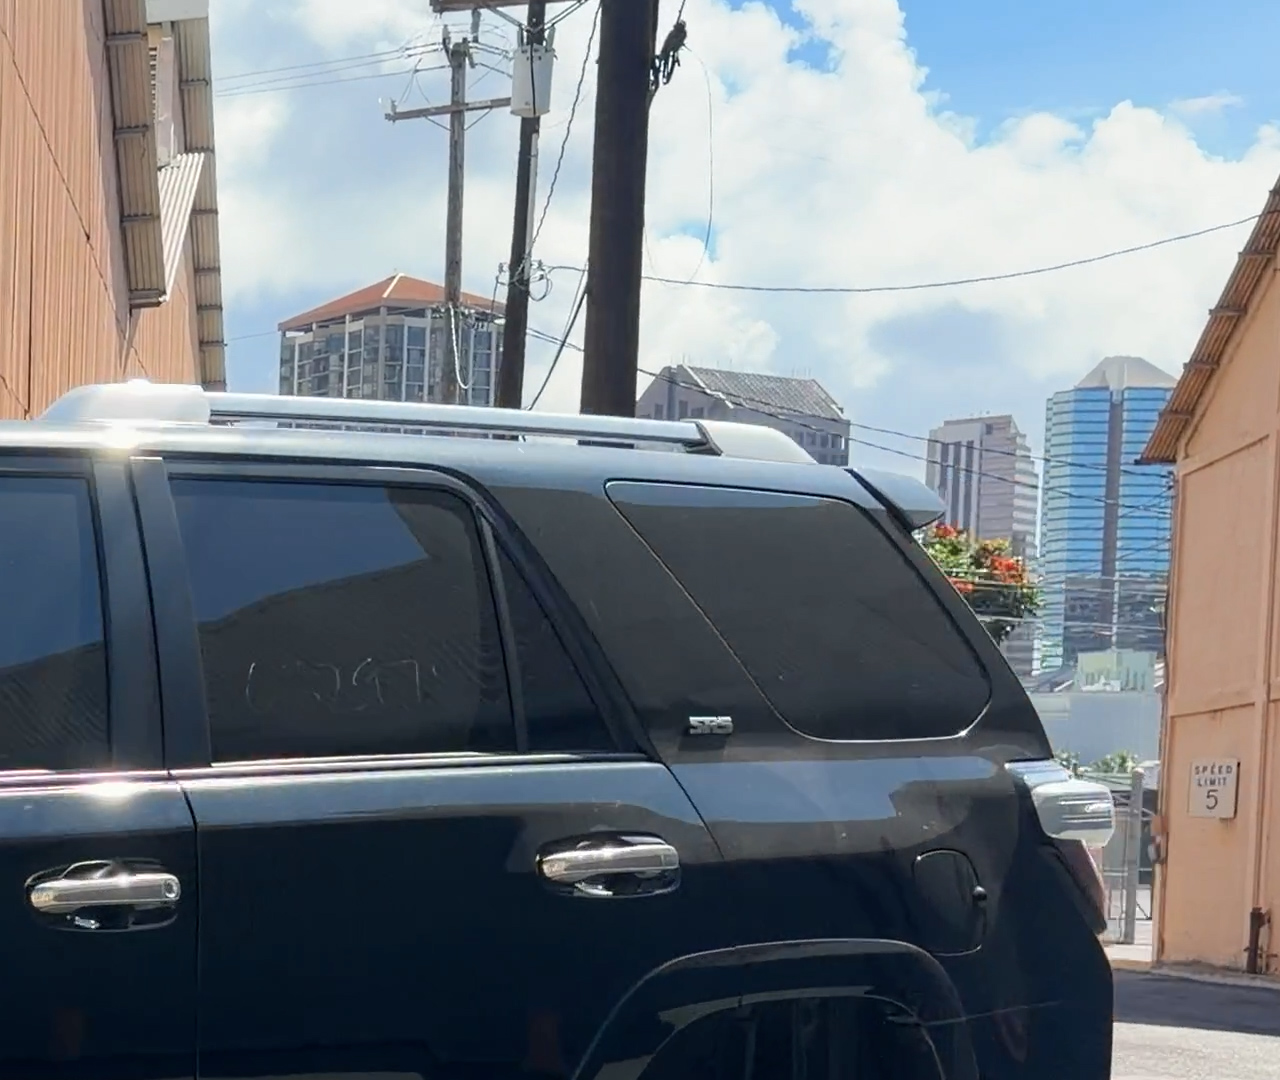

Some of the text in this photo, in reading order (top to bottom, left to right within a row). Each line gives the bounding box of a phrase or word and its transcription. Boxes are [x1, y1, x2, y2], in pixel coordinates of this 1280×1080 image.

[1194, 764, 1233, 776] SPEED
[1196, 776, 1227, 787] LIMIT
[1205, 788, 1218, 810] 5
